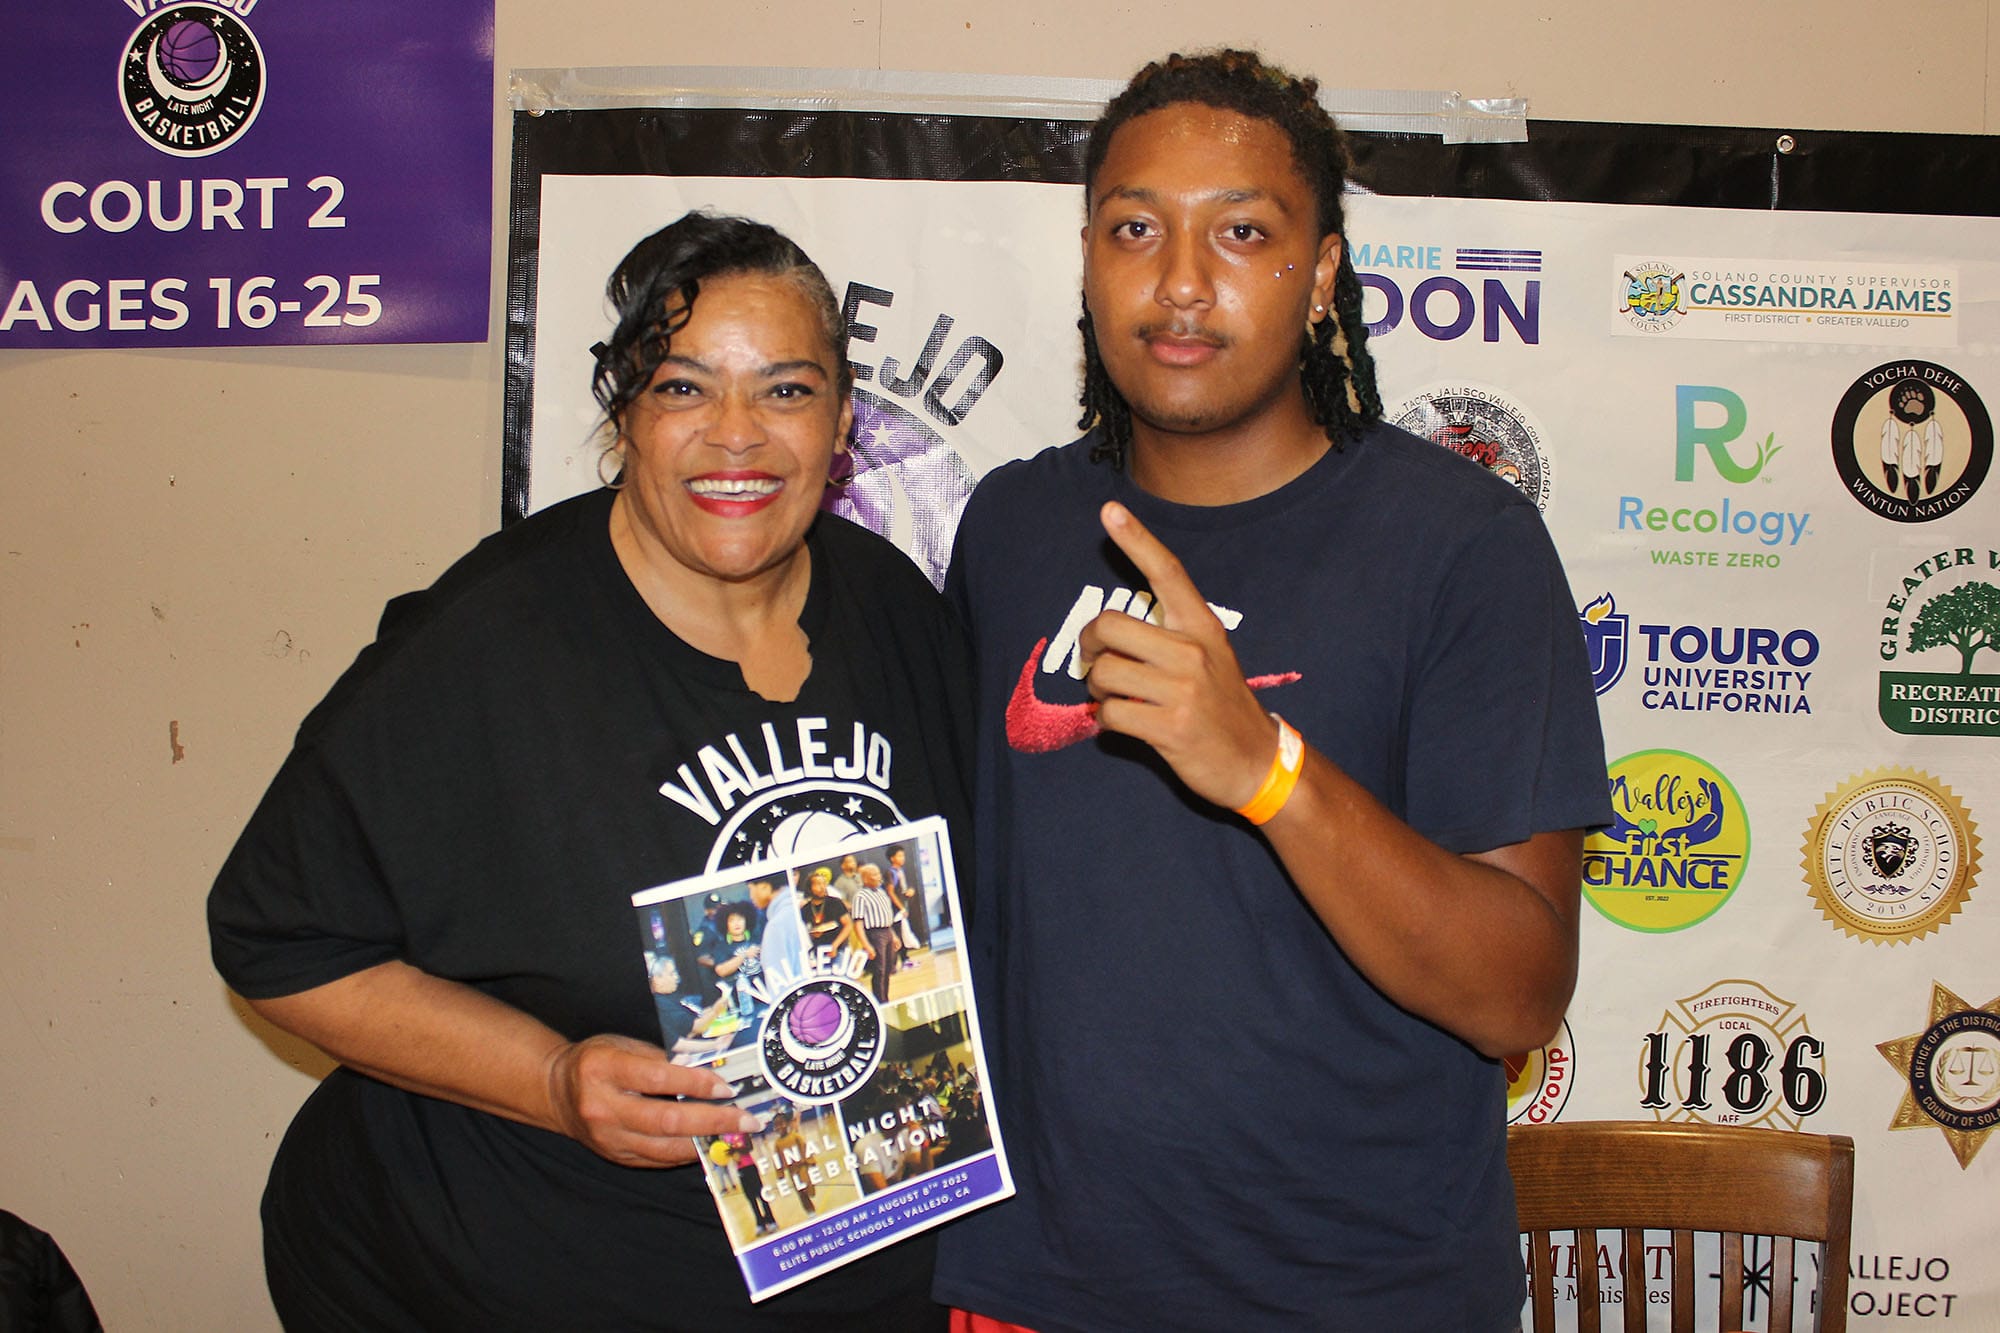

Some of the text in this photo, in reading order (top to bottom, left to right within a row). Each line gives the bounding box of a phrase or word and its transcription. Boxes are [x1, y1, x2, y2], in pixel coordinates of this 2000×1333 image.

[135, 96, 251, 145] BASKETBALL
[167, 100, 215, 115] LATE NIGHT
[41, 176, 346, 233] COURT 2
[1349, 244, 1441, 270] MARIE
[1636, 263, 1675, 276] SOLANO
[1692, 271, 1952, 289] SOLANO COUNTY SUPERVISOR
[0, 275, 383, 331] AGES 16-25
[1690, 283, 1952, 313] CASSANDRA JAMES
[1630, 316, 1674, 332] COUNTY
[1725, 313, 1909, 328] FIRST DISTRICT GREATER VALLEJO
[1437, 387, 1486, 400] JALISCO
[1864, 366, 1962, 394] YOCHA DEHE
[1853, 478, 1971, 517] WINTUN NATION
[1618, 496, 1811, 546] Recology
[1651, 550, 1781, 568] WASTE ZERO
[1880, 547, 1975, 661] GREATER
[1639, 625, 1820, 667] TOURO
[1644, 667, 1812, 691] UNIVERSITY
[1642, 690, 1812, 714] CALIFORNIA
[1909, 707, 2000, 725] DISTRIC
[659, 717, 892, 826] VALLEJO
[1621, 774, 1710, 823] Vallejo
[1841, 796, 1913, 830] PUBLIC
[1625, 829, 1690, 857] First
[1583, 855, 1729, 889] CHANCE
[1866, 903, 1907, 915] 2019
[743, 945, 868, 1005] VALLEJO
[1693, 997, 1780, 1016] FIREFIGHTERS
[1719, 1021, 1751, 1030] LOCAL
[805, 1059, 825, 1071] LATE
[1914, 1043, 1930, 1079] OFFICE
[1928, 1029, 1941, 1045] OF
[1940, 1019, 1961, 1034] THE
[777, 1038, 874, 1094] BASKETBALL
[1640, 1032, 1827, 1117] 1186
[1528, 1048, 1569, 1123] Group
[1718, 1114, 1740, 1123] IAFF
[1922, 1095, 1959, 1125] COUNTY
[1961, 1115, 1975, 1127] OF
[757, 1098, 932, 1176] FINAL NIGHT
[760, 1121, 946, 1202] CELEBRATION
[772, 1241, 797, 1257] 6:00
[797, 1234, 814, 1248] PM
[822, 1220, 849, 1237] 12:00
[852, 1211, 868, 1225] AM
[878, 1191, 919, 1214] AUGUST
[942, 1171, 968, 1189] 2025
[779, 1253, 808, 1272] ELITE
[809, 1237, 845, 1259] PUBLIC
[847, 1216, 895, 1243] SCHOOLS
[955, 1186, 971, 1198] CA
